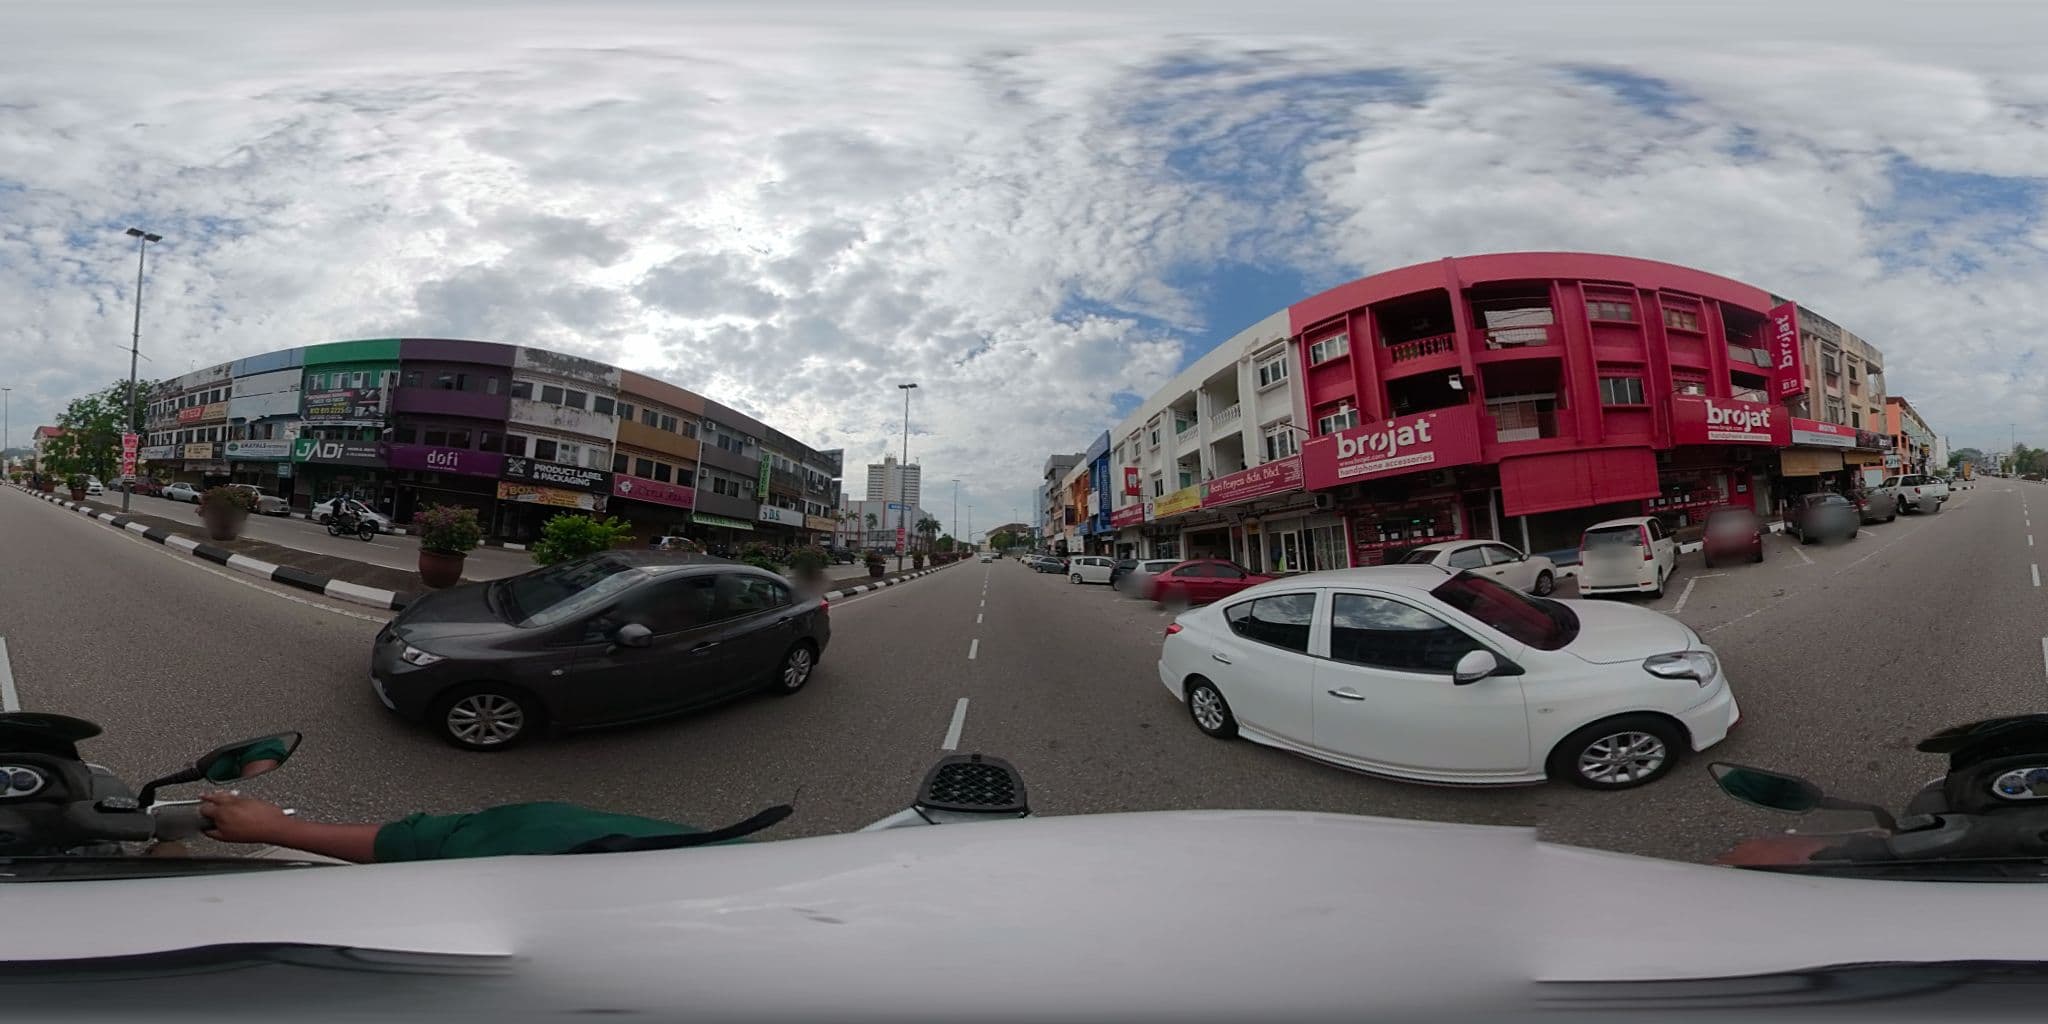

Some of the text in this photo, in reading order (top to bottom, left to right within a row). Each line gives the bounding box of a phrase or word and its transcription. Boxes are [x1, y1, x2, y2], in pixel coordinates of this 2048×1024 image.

[1775, 314, 1795, 370] brojat
[1704, 399, 1770, 432] brojat
[1335, 418, 1432, 459] brojat
[427, 450, 458, 466] dofi
[1339, 453, 1433, 477] handphone accessories
[533, 471, 590, 486] & PACKAGING
[534, 463, 603, 481] PRODUCT LABEL
